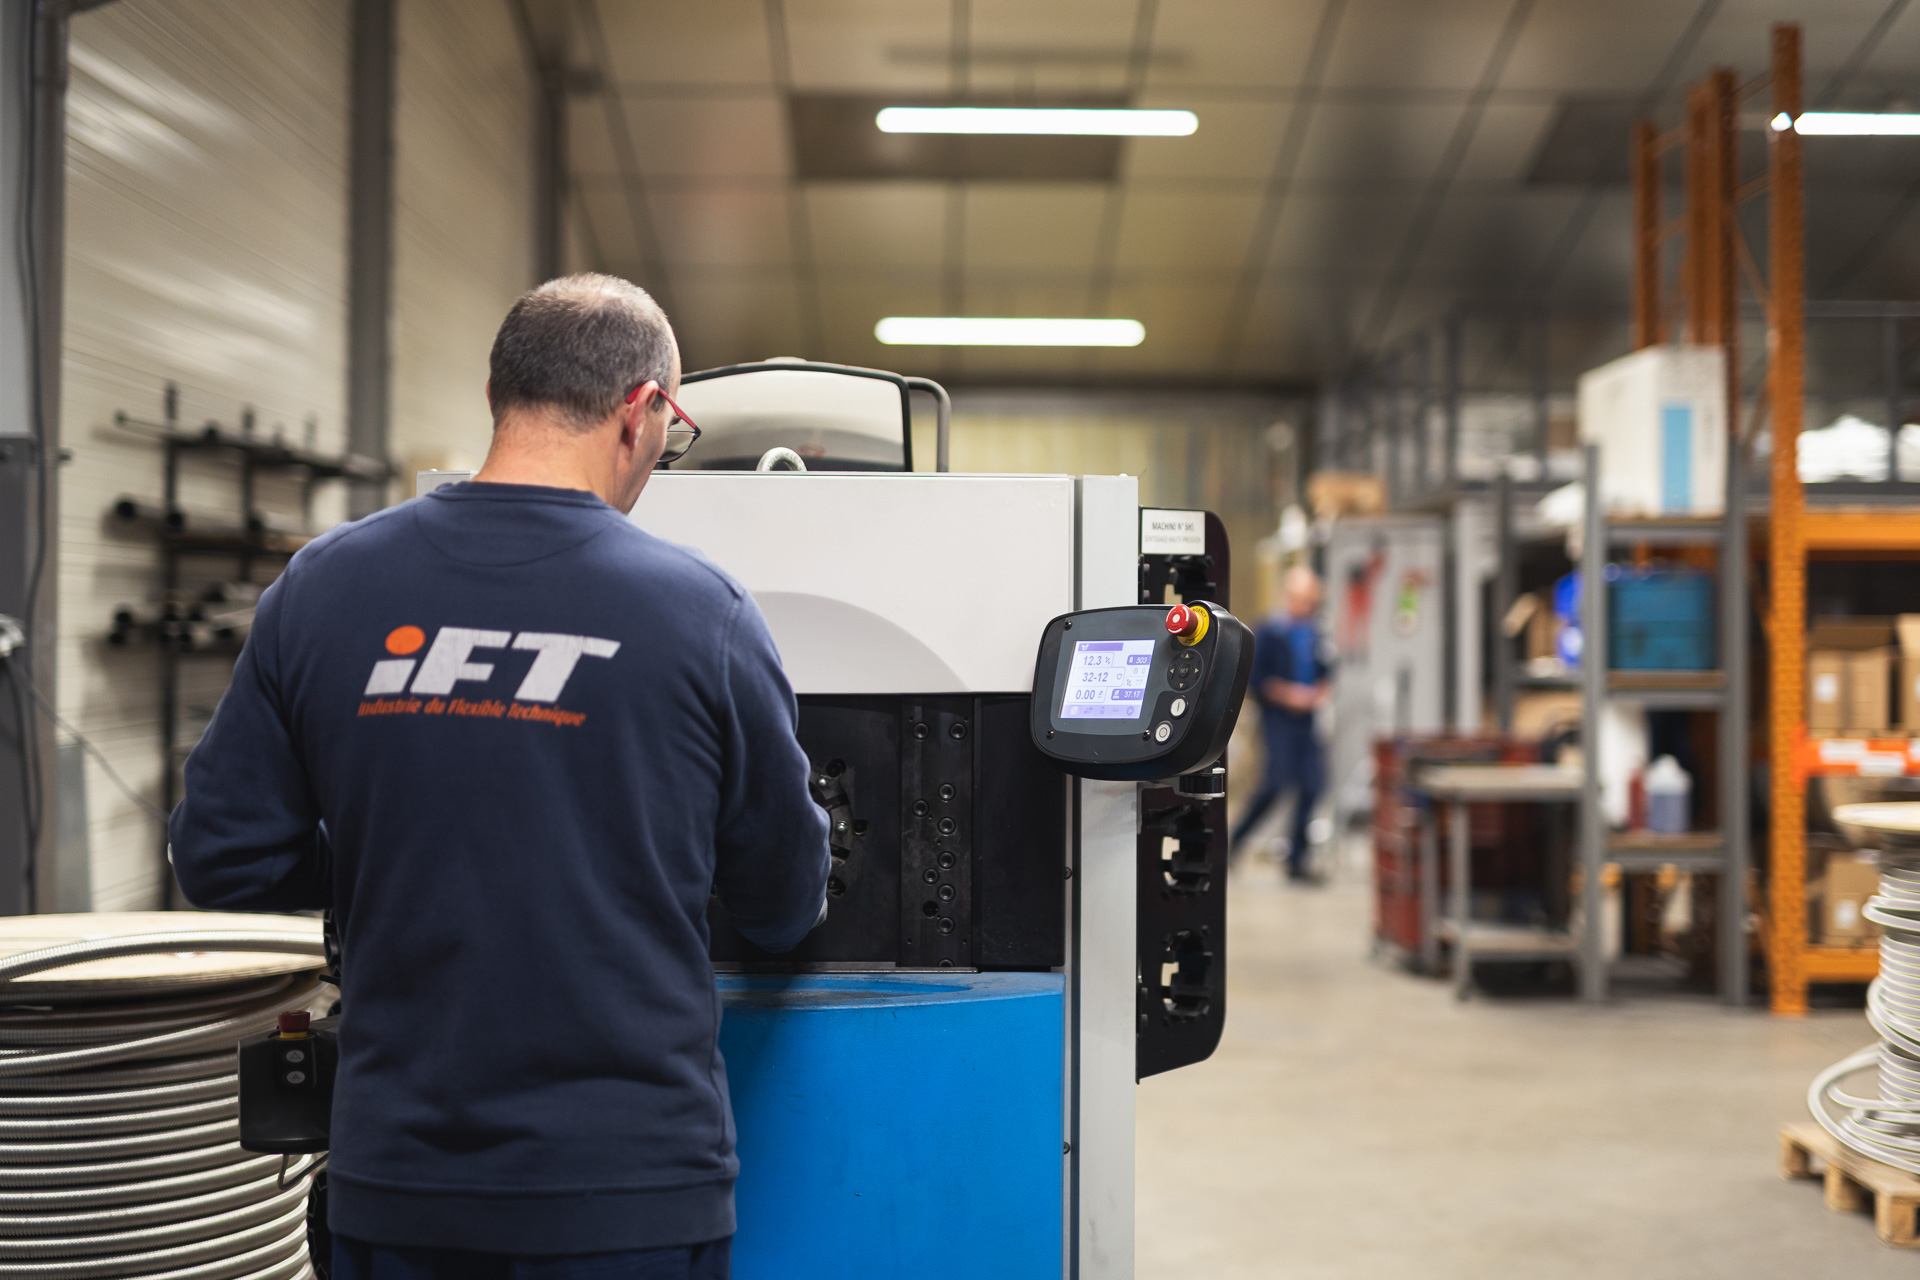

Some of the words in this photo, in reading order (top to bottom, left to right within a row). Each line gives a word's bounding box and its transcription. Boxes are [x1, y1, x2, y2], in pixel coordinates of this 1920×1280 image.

[1152, 521, 1176, 531] MACHINE
[1083, 655, 1102, 666] 12.3
[1136, 656, 1147, 664] 503
[1082, 672, 1109, 682] 32-12
[1075, 689, 1096, 700] 0.00
[1124, 690, 1141, 698] 37.17
[357, 697, 422, 717] Industrie
[423, 697, 447, 714] du
[447, 698, 506, 718] Flexible
[507, 702, 587, 727] Technique
